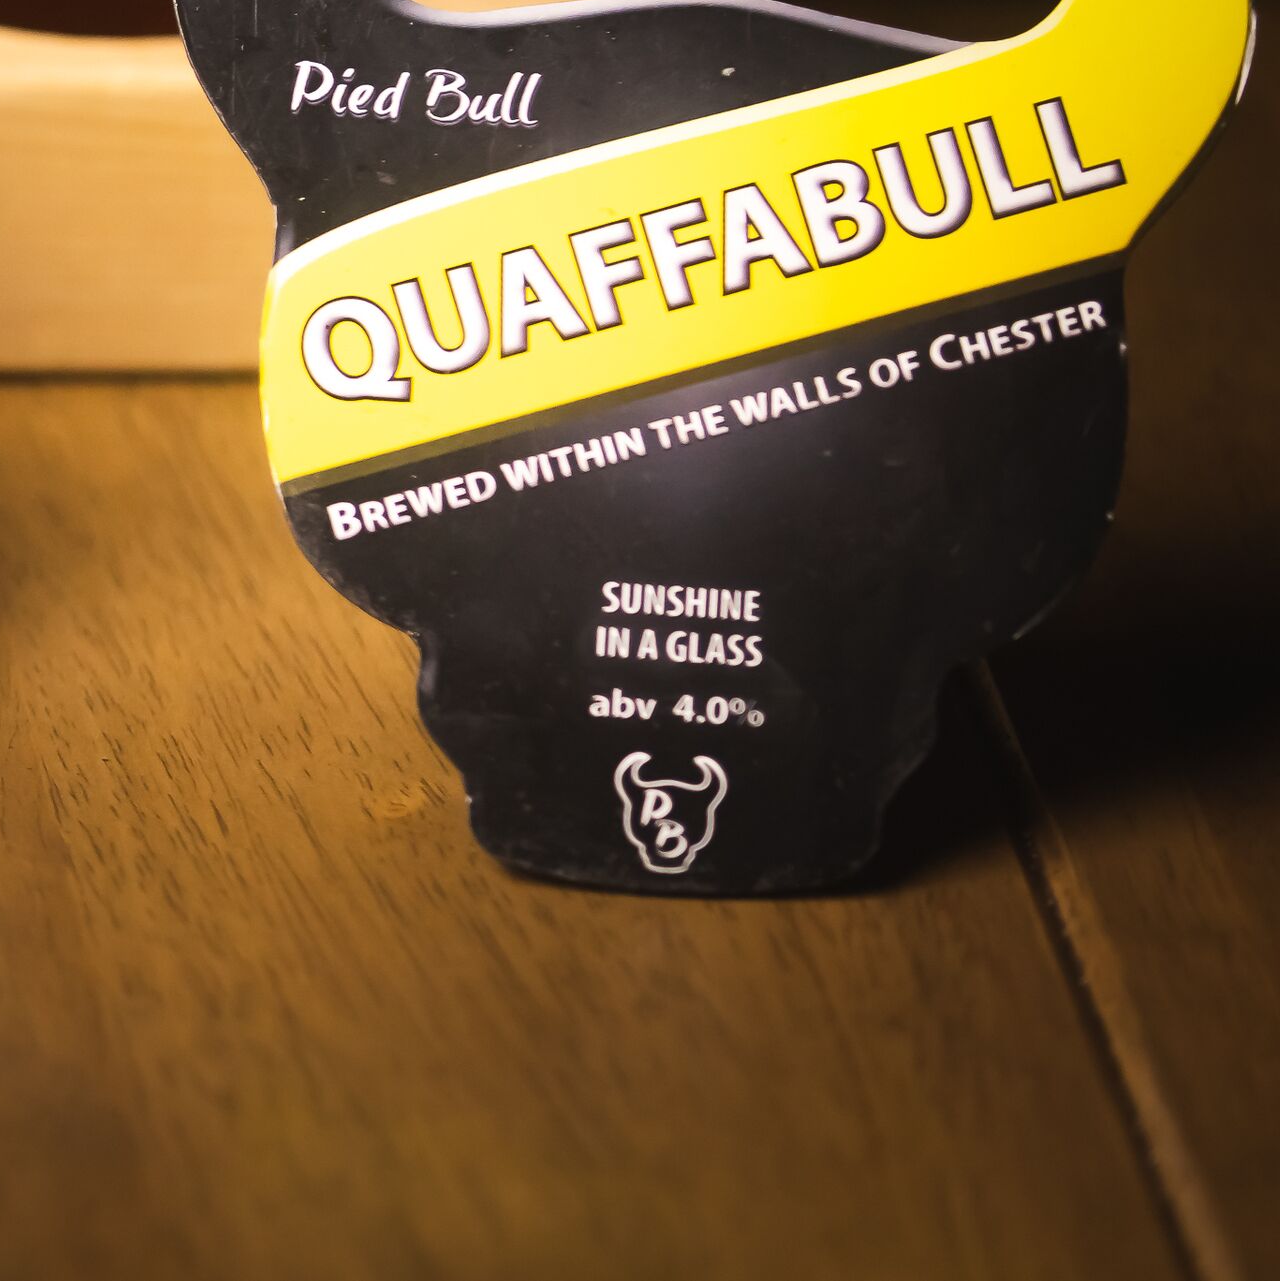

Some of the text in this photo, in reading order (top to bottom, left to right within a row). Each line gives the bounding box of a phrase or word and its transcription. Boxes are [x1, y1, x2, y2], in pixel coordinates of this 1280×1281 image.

[289, 60, 543, 128] Pied Bull
[300, 95, 1128, 404] QUAFFABULL
[326, 300, 1108, 542] BREWED WITHIN THE WALLS OF CHESTER
[601, 581, 761, 622] SUNSHINE
[595, 625, 763, 667] IN A GLASS
[589, 688, 765, 727] abv 4.0%
